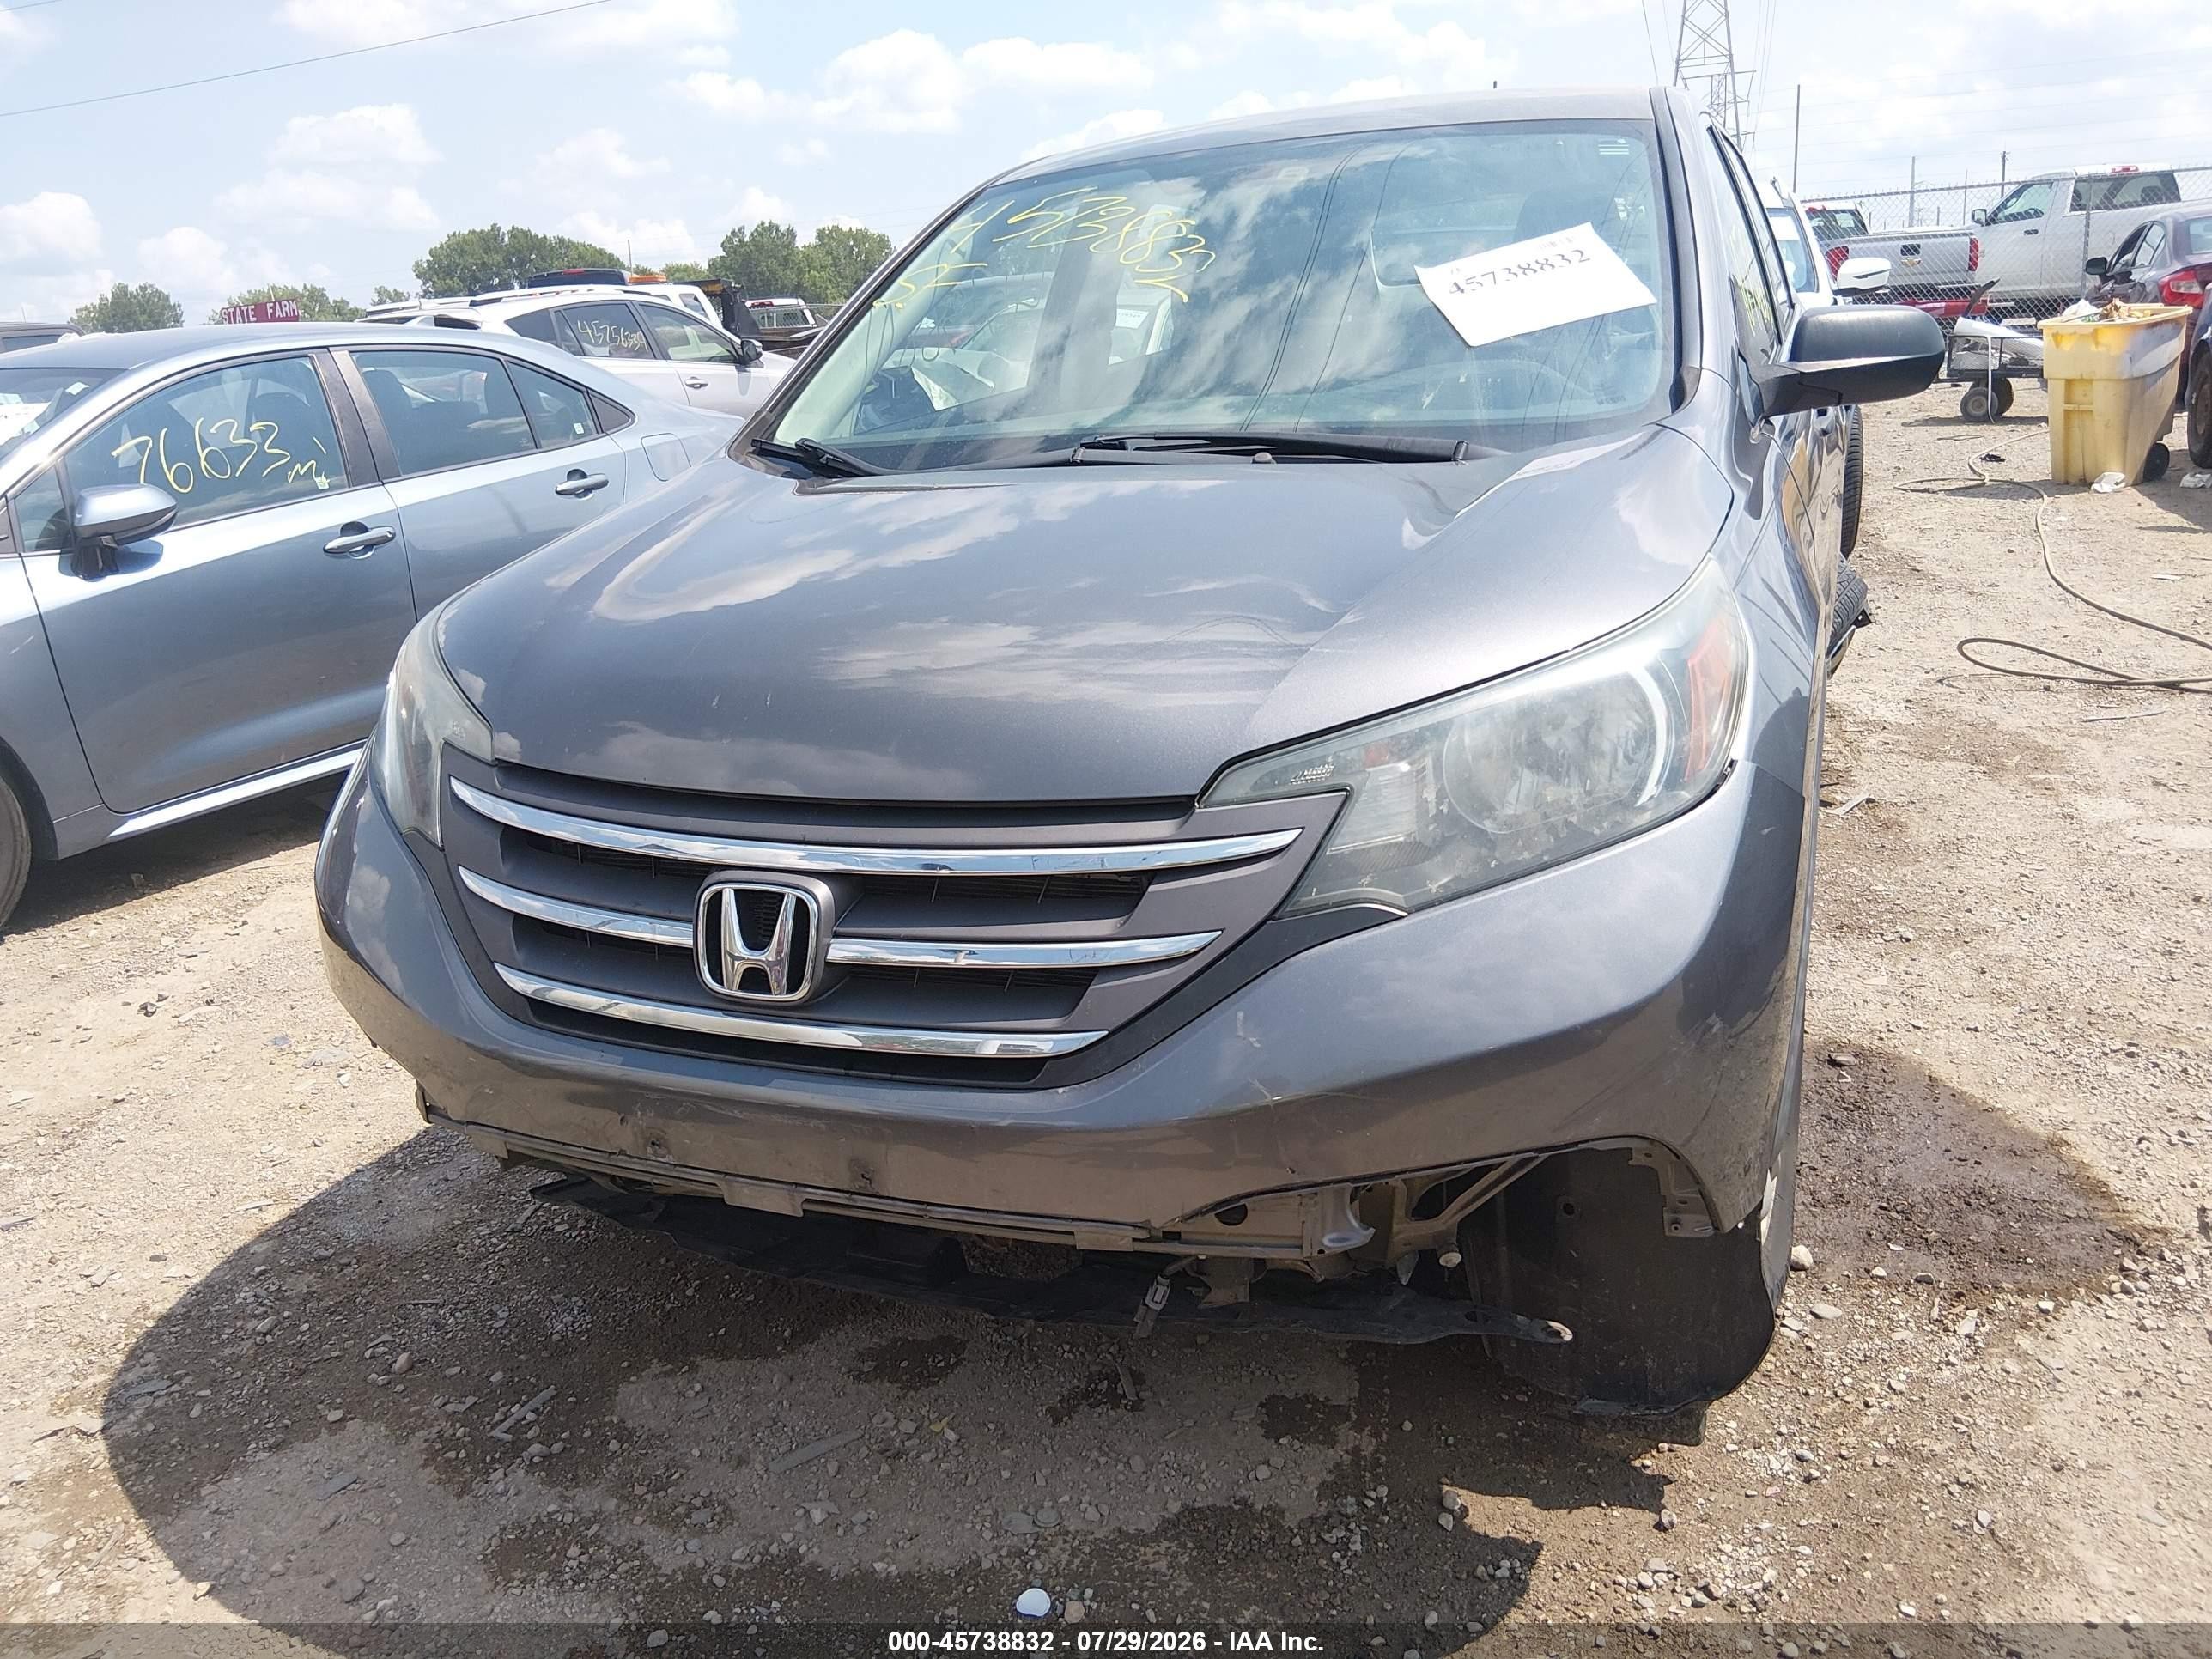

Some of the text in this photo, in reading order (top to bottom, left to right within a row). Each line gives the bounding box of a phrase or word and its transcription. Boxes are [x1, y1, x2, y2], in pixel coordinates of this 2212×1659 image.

[1449, 248, 1591, 295] 45738832
[222, 300, 298, 325] STATE FARM
[110, 417, 291, 493] 76633
